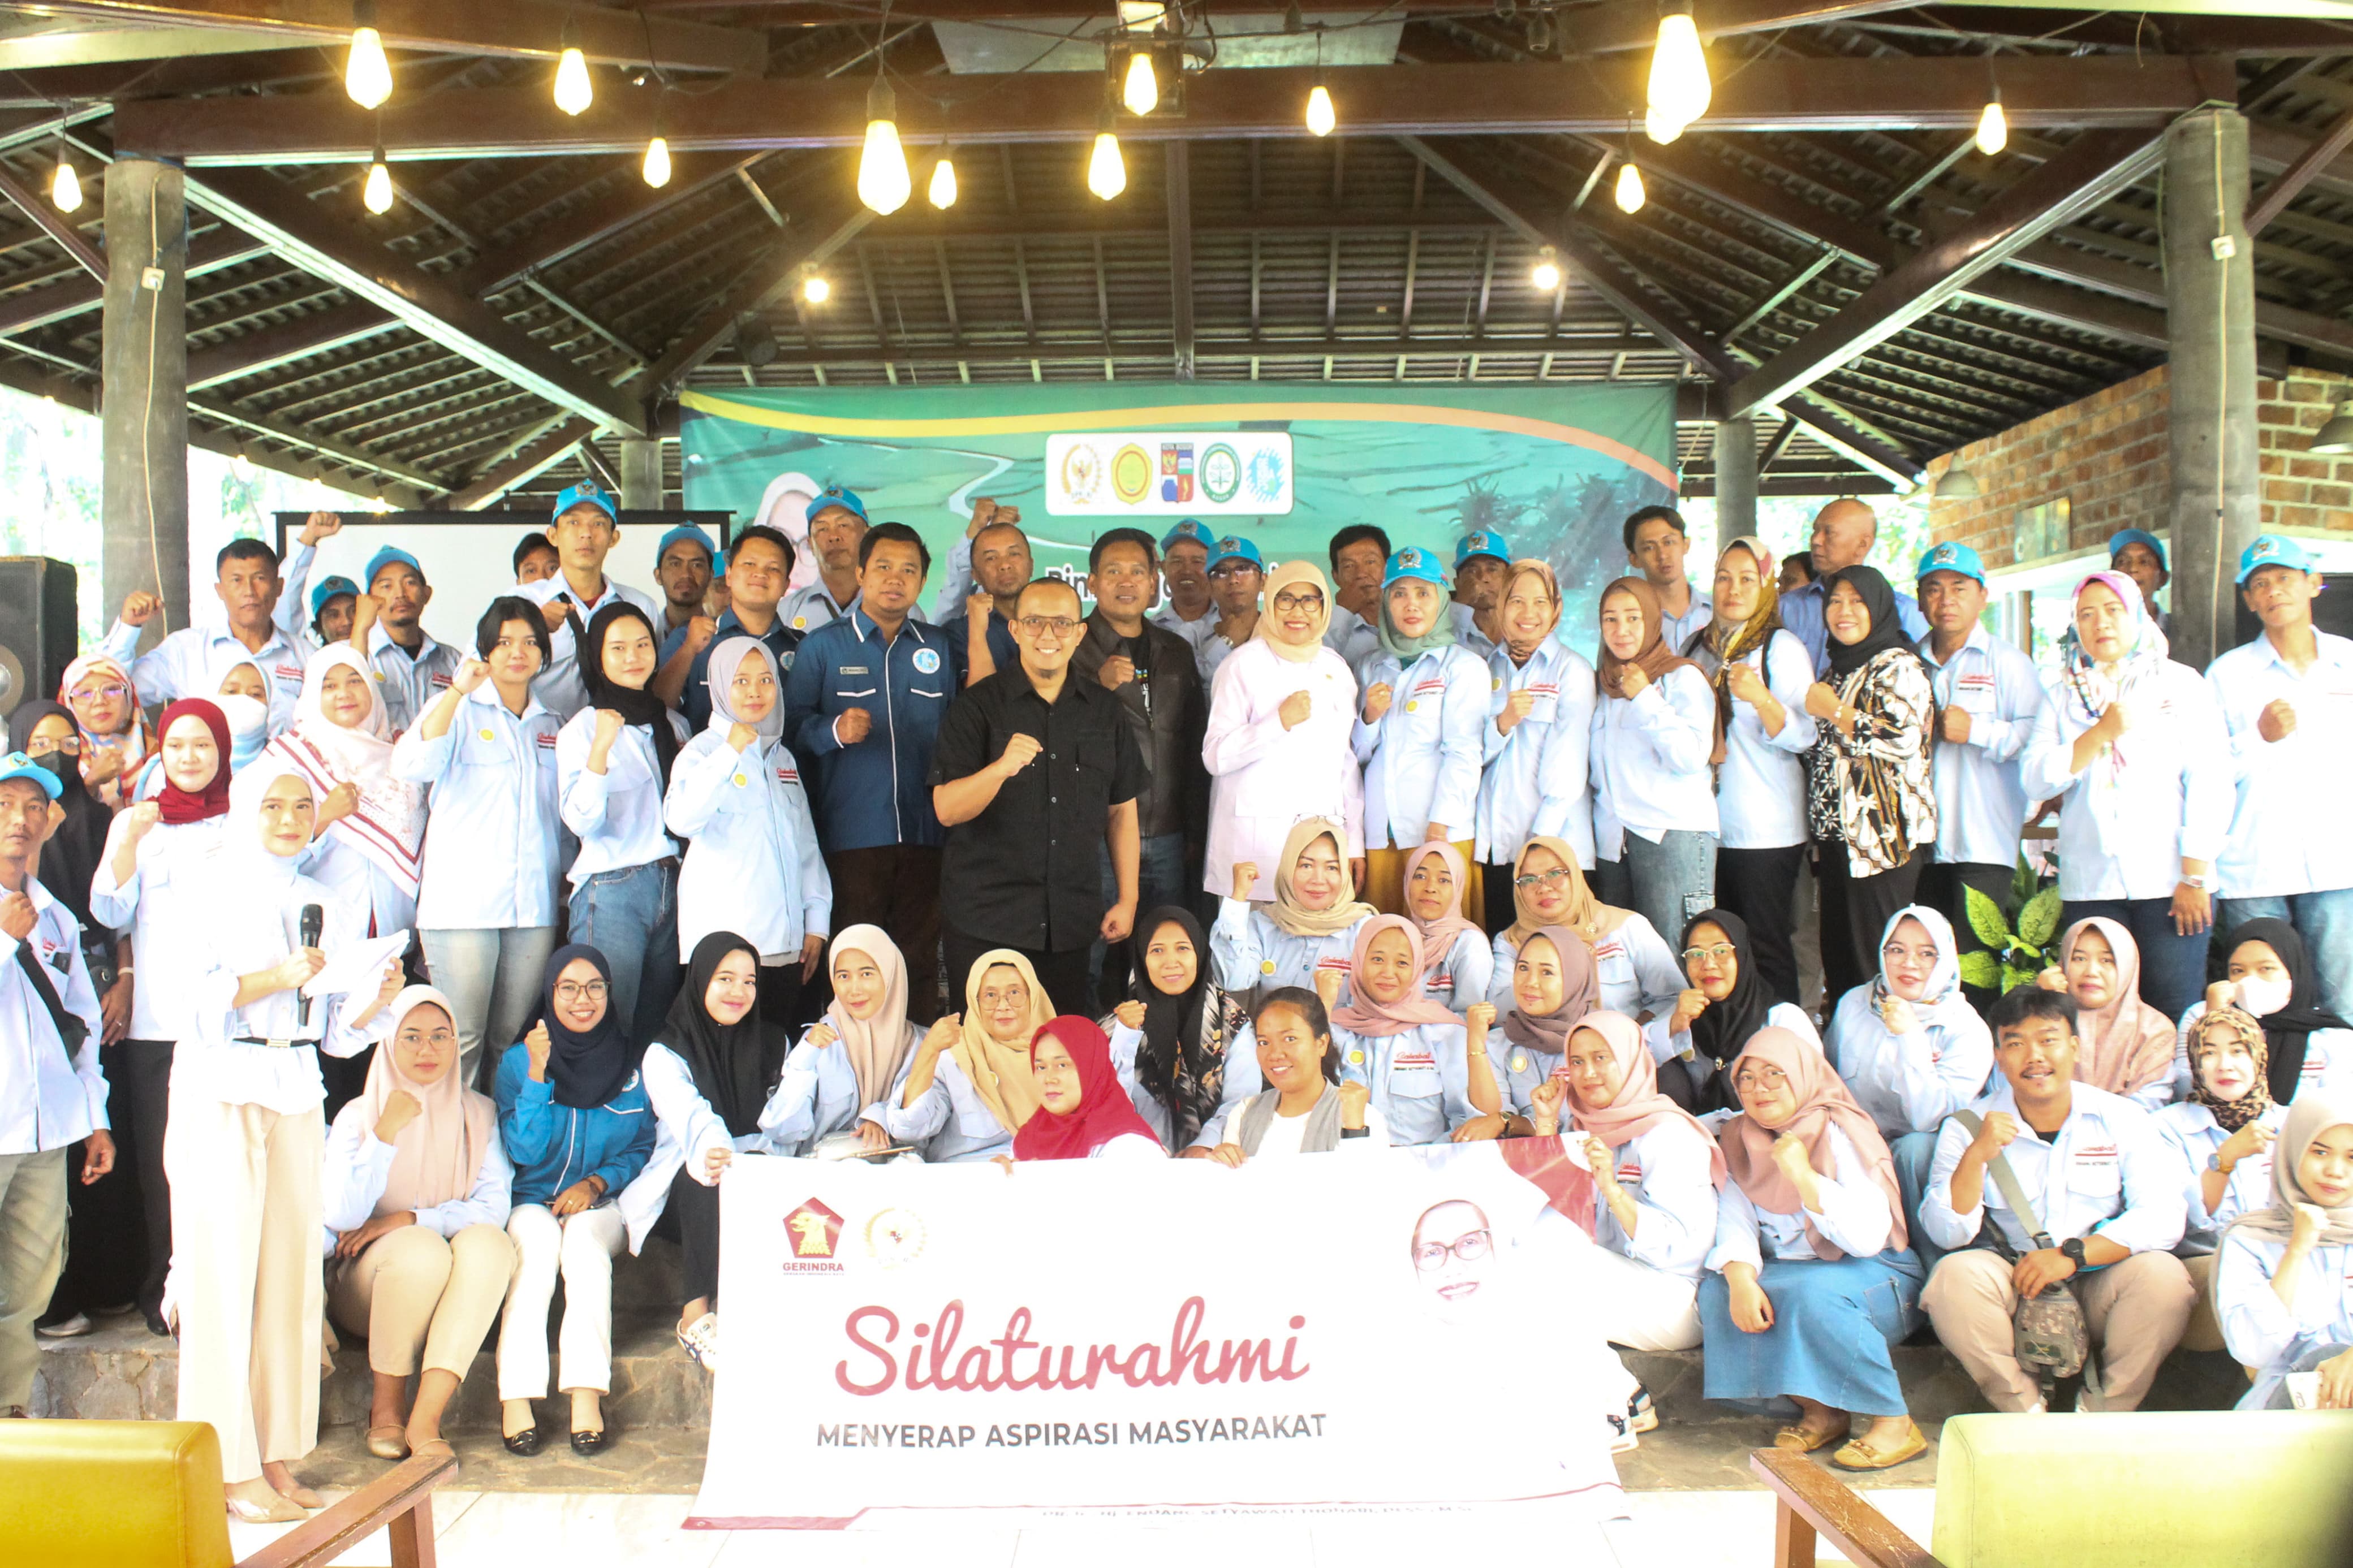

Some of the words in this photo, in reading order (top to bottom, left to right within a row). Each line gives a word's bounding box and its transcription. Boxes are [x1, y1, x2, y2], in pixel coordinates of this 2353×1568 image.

[783, 1262, 844, 1271] GERINDRA
[834, 1295, 1310, 1396] Silaturahmi
[817, 1423, 975, 1448] MENYERAP
[985, 1422, 1118, 1447] ASPIRASI
[1129, 1414, 1326, 1444] MASYARAKAT
